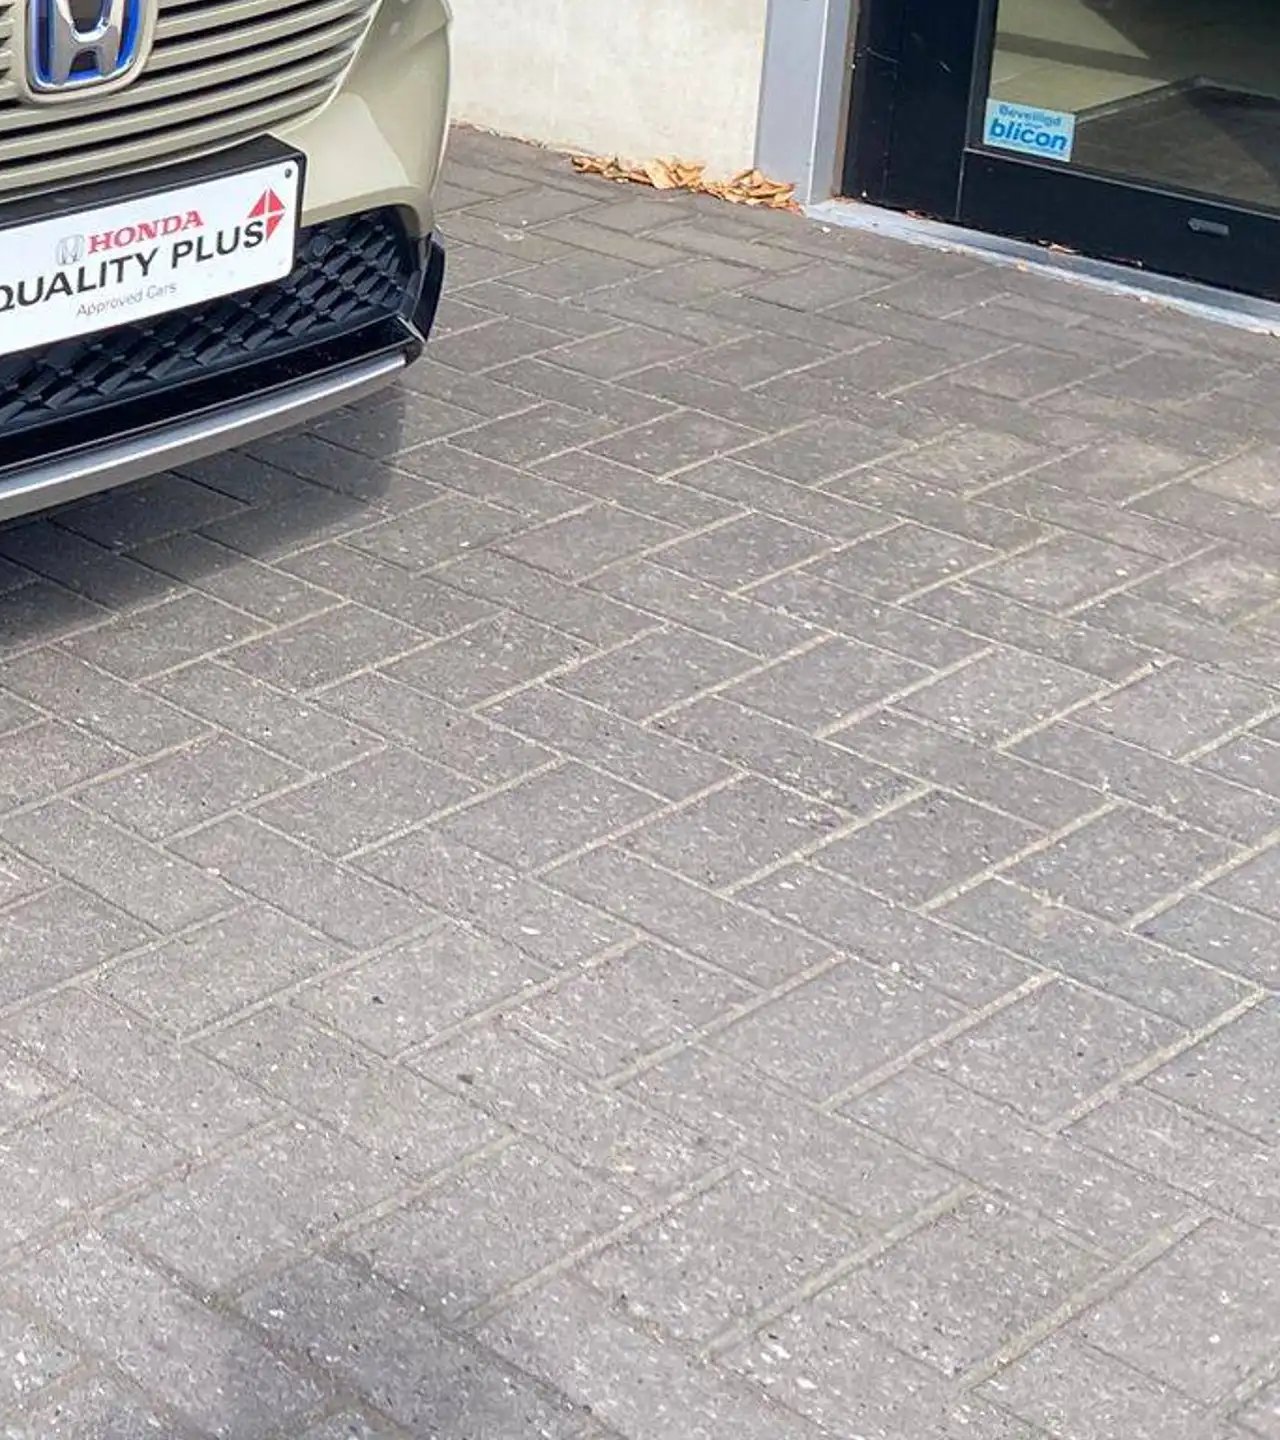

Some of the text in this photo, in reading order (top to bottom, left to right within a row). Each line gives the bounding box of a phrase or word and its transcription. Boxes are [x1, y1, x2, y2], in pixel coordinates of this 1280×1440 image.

[989, 118, 1068, 150] blicon
[87, 210, 204, 255] HONDA
[171, 220, 265, 269] PLUS
[76, 282, 178, 317] Approved Cars
